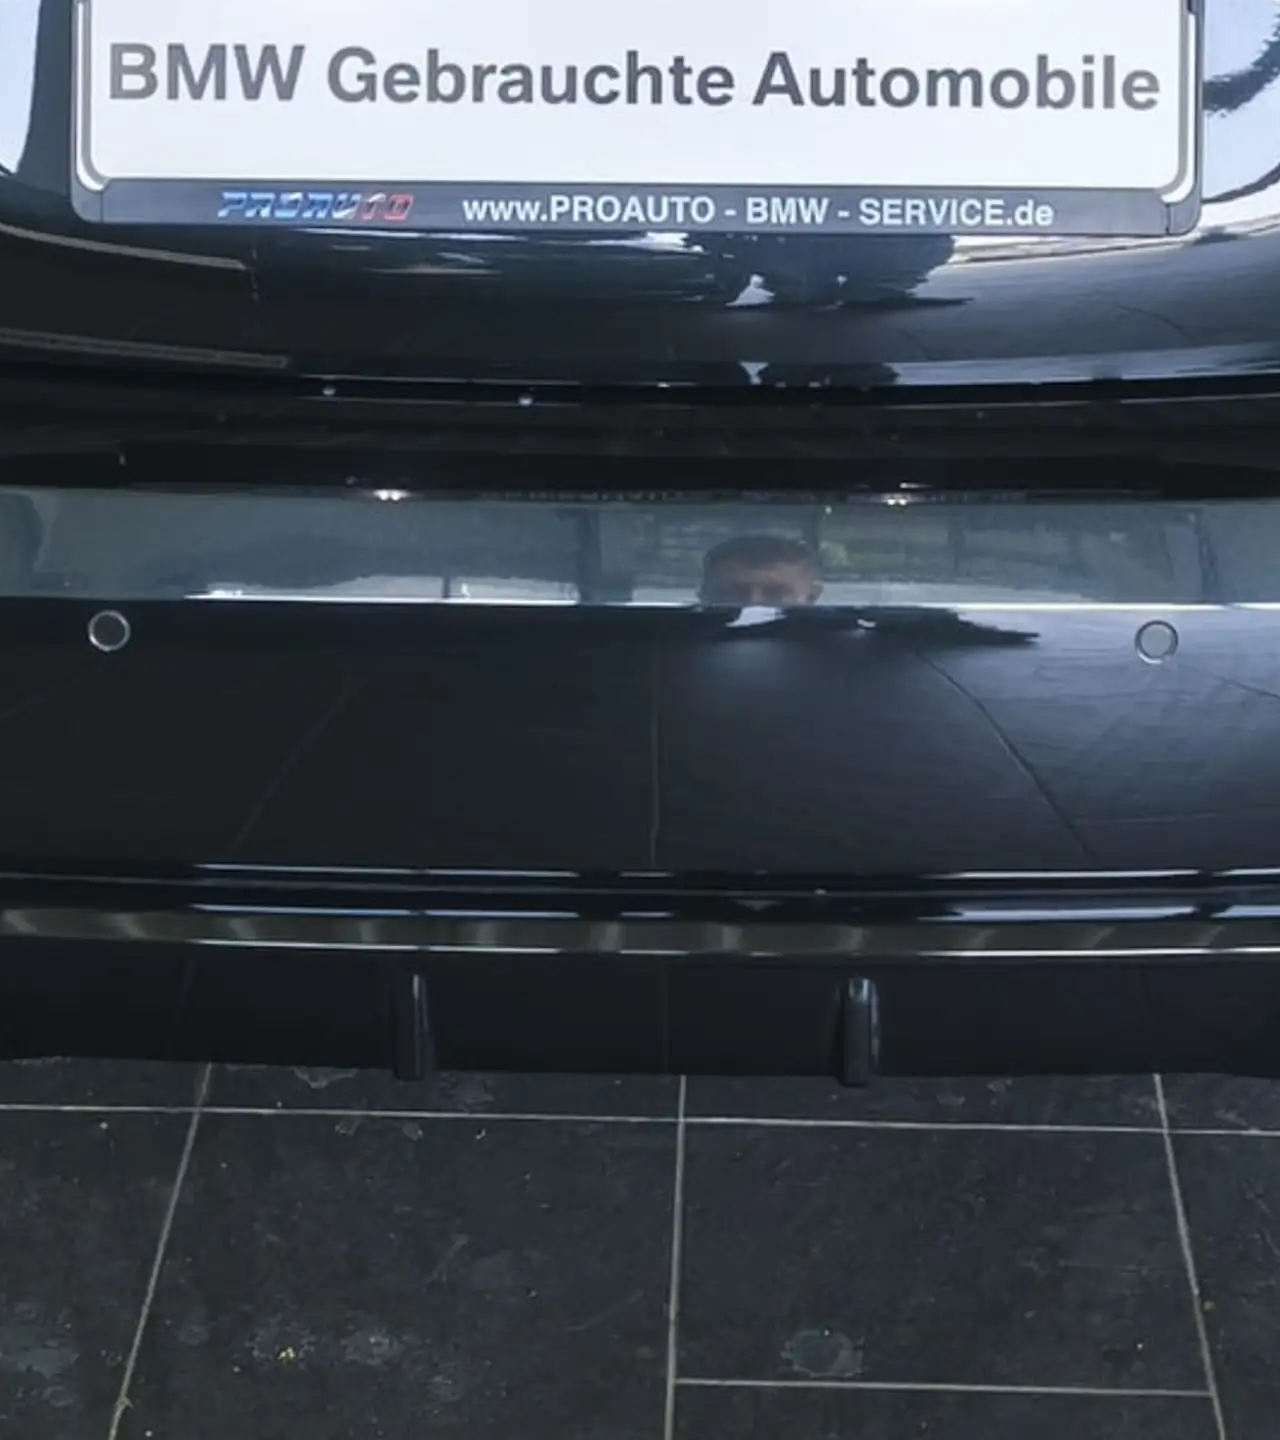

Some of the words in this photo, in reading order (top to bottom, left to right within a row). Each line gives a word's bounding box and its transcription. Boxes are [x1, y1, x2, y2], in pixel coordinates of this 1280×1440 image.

[108, 42, 305, 101] BMW
[327, 45, 736, 106] Gebrauchte
[751, 50, 1162, 112] Automobile
[462, 193, 716, 224] www.PROAUTO
[746, 196, 829, 225] BMW
[858, 197, 1054, 227] SERVICE.de
